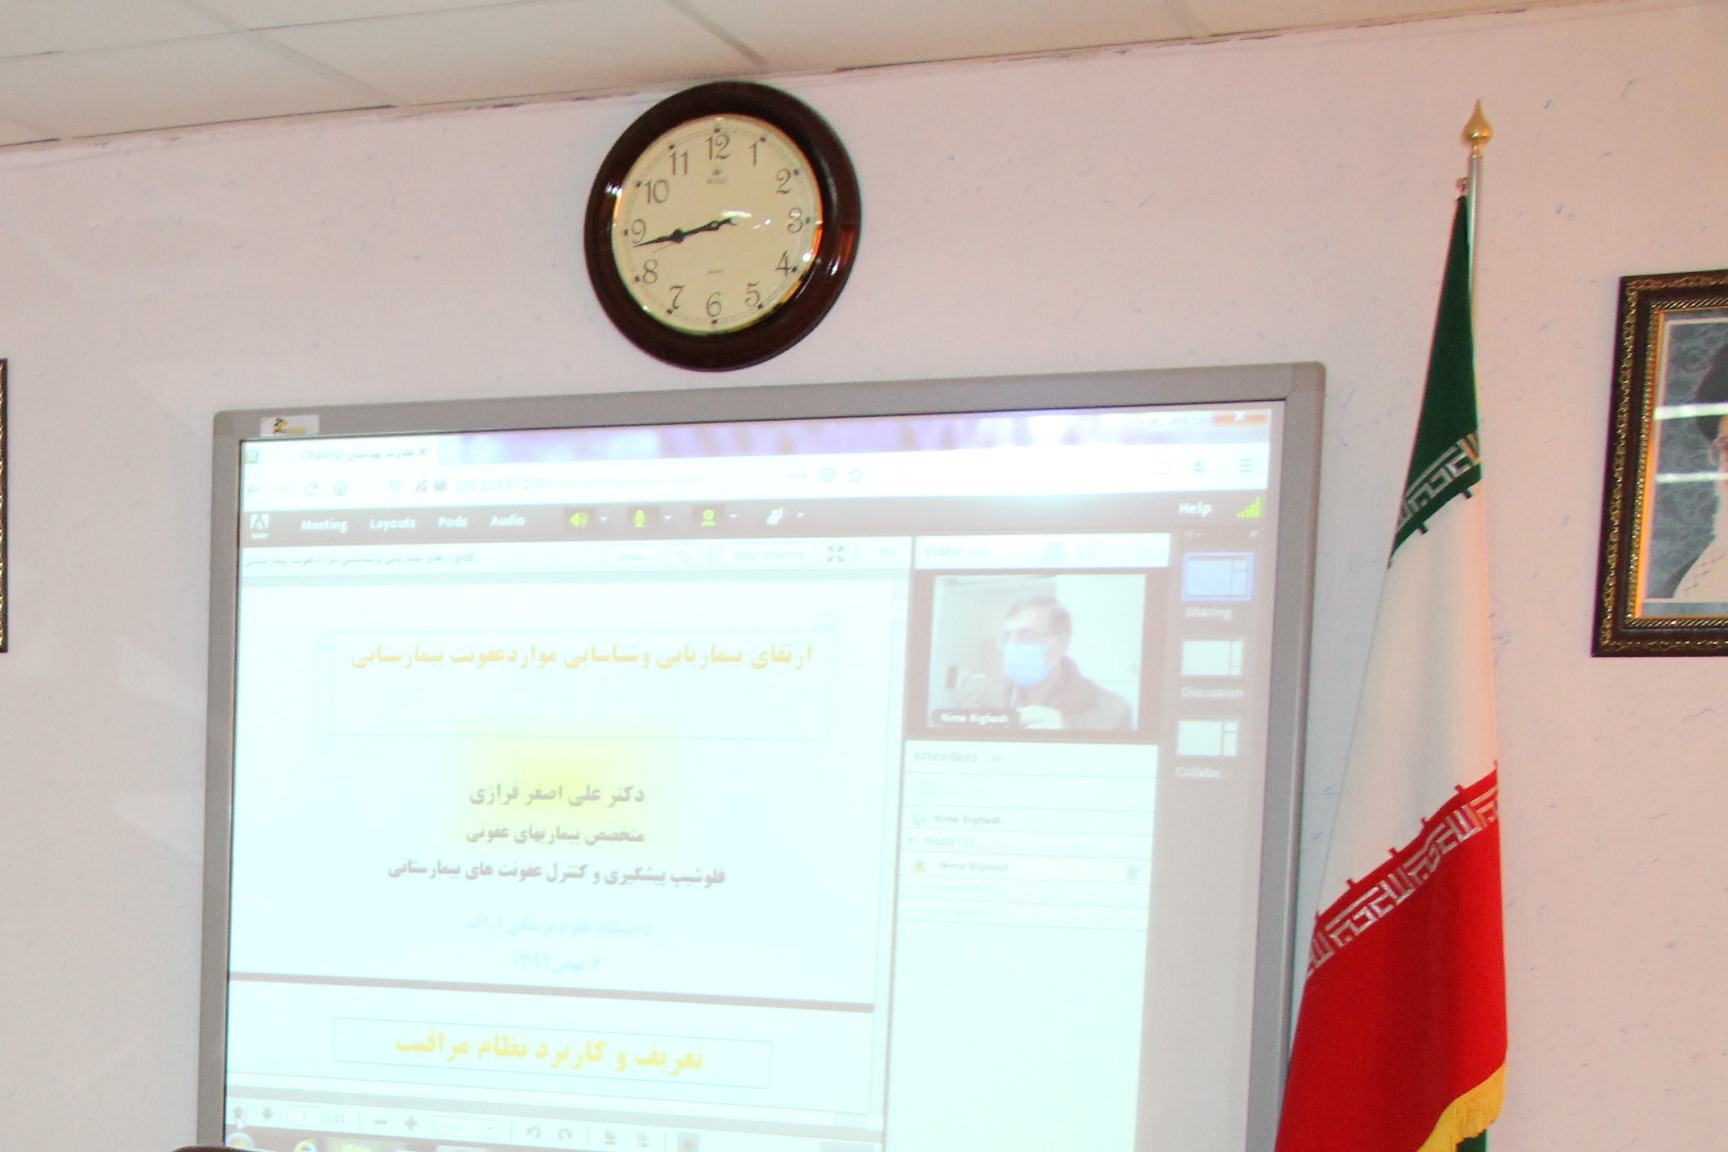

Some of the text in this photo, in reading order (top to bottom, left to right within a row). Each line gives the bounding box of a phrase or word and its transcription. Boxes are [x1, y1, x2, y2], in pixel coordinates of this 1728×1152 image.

[705, 134, 731, 160] 12
[749, 141, 758, 167] 1
[669, 151, 689, 176] 11
[644, 179, 669, 204] 10
[777, 168, 791, 194] 2
[631, 218, 646, 242] 9
[787, 207, 804, 233] 3
[642, 259, 659, 285] 8
[776, 251, 791, 276] 4
[669, 285, 686, 310] 7
[706, 292, 721, 317] 6
[745, 282, 761, 306] 5
[1179, 501, 1212, 517] Help
[301, 512, 526, 533] Meeting Layouts Pods Audio
[351, 643, 444, 670] بیمارستانی
[469, 780, 645, 807] دکتر علی اصغر فرازی
[466, 822, 510, 844] عفونی
[585, 826, 645, 846] متخصص
[388, 858, 461, 880] بیمارستانی
[465, 861, 494, 881] های
[498, 862, 542, 882] عفونت
[545, 863, 588, 883] کنترل
[604, 864, 666, 887] پیشگیری
[394, 1027, 704, 1077] تعریف و کاربرد نظام مراقبت
